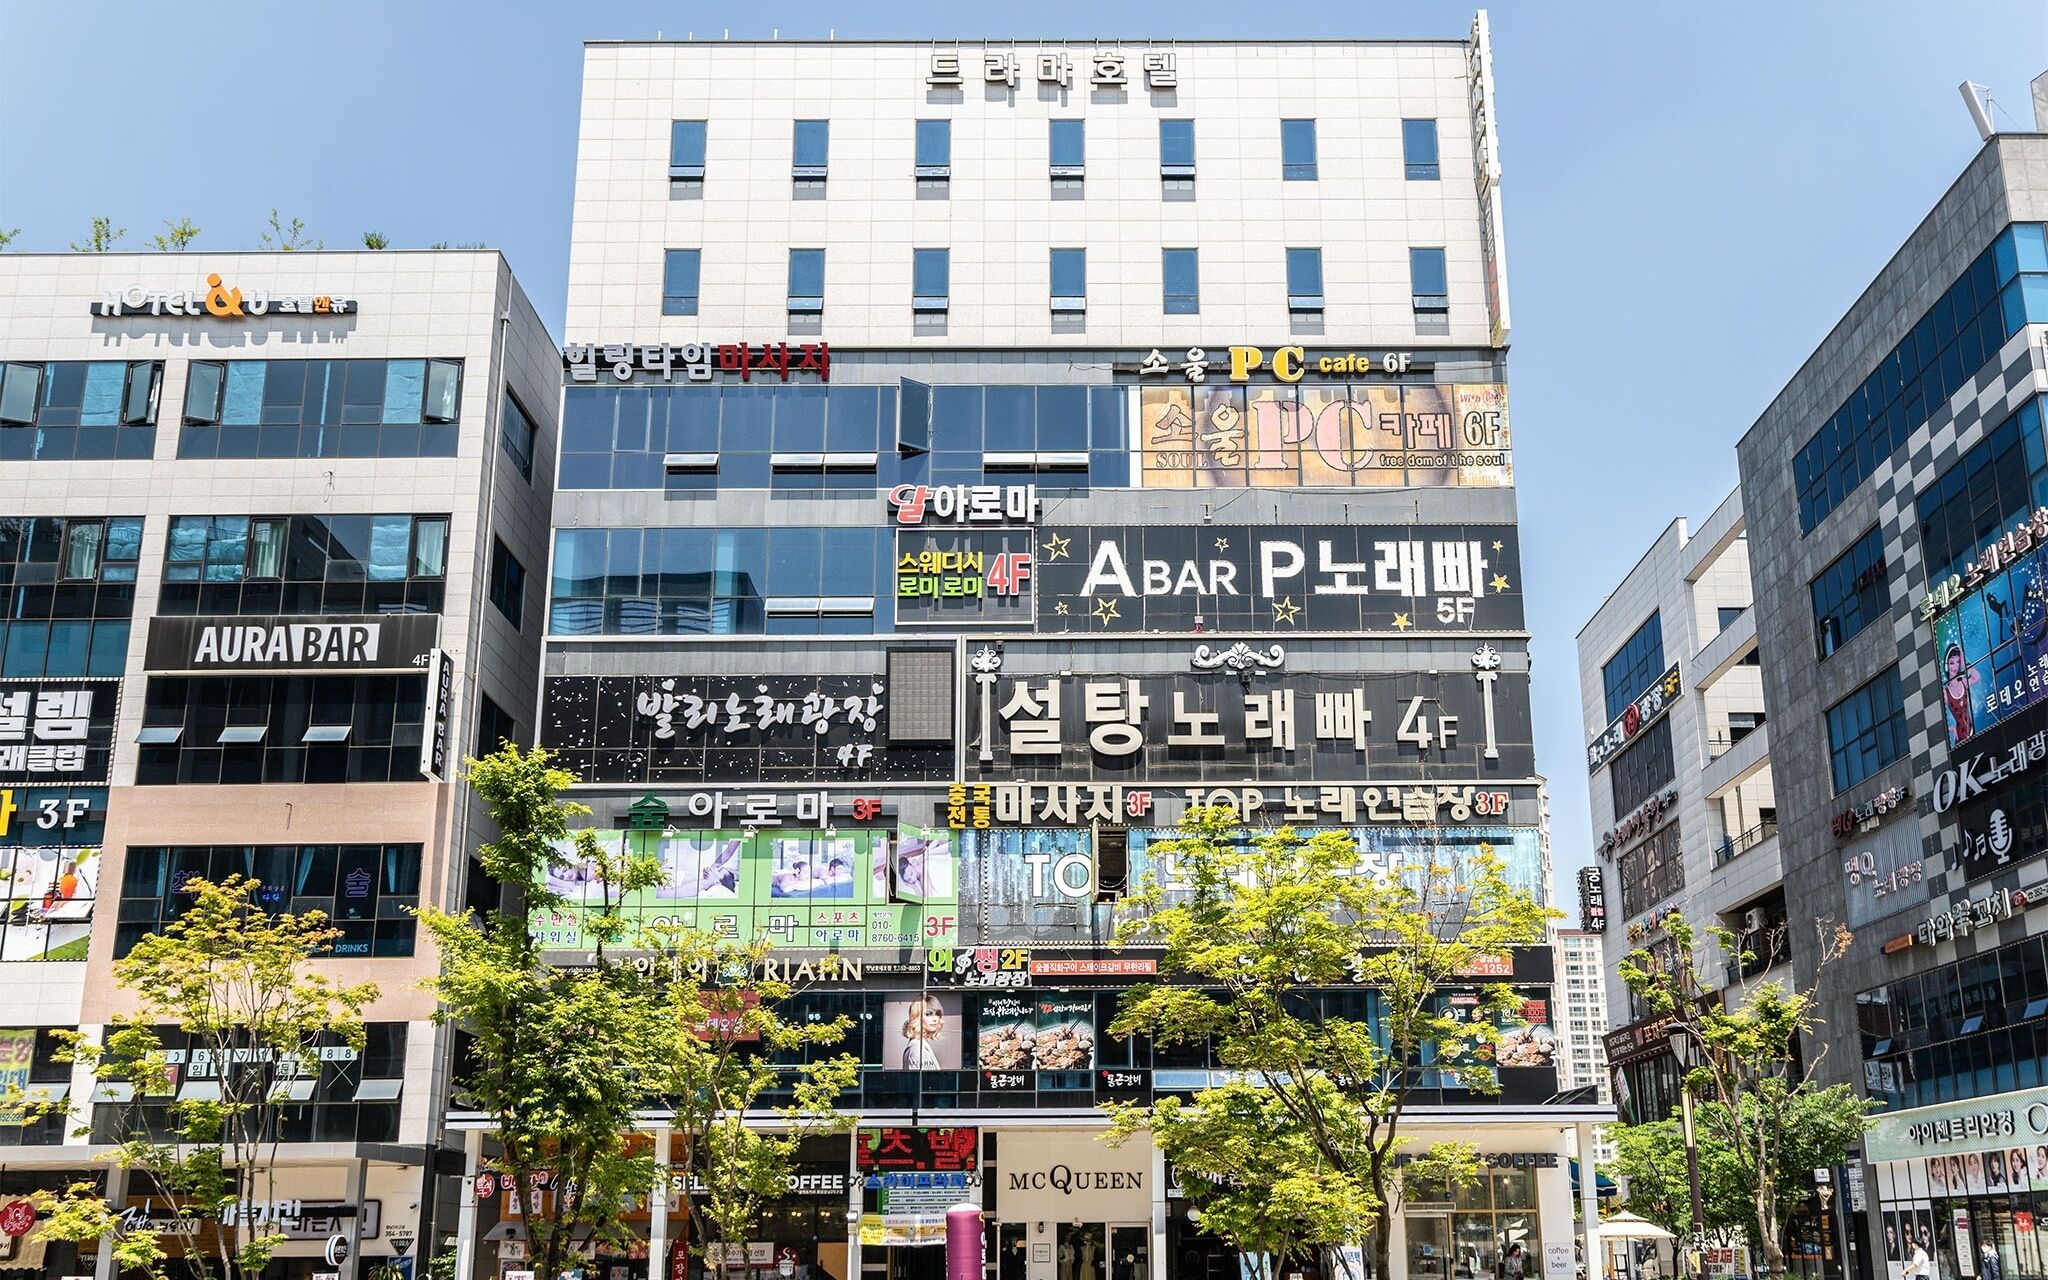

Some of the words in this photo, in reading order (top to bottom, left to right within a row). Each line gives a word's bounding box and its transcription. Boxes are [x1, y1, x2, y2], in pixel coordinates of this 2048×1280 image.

[926, 51, 1178, 88] 드라마호텔
[101, 284, 199, 316] HOTEL
[250, 290, 268, 315] U
[279, 296, 348, 313] 호텔앤유
[564, 342, 713, 382] 힐링타임
[718, 341, 830, 381] 마사지
[1228, 346, 1306, 383] PC
[1319, 352, 1370, 374] cafe
[1382, 351, 1411, 372] 6F
[1251, 399, 1375, 473] PC
[1379, 412, 1454, 450] 카페
[1463, 410, 1501, 447] 6F
[1156, 451, 1208, 469] SOUL
[1476, 454, 1505, 467] soul
[898, 550, 983, 575] 스웨디시
[986, 552, 1032, 597] 4F
[1436, 597, 1475, 623] 5F
[195, 626, 288, 663] AURA
[300, 626, 371, 663] BAR
[412, 652, 430, 667] 4F
[438, 660, 452, 717] AURA
[1985, 679, 2026, 714] 로데오
[1395, 694, 1459, 750] 4F
[434, 722, 446, 767] BAR
[835, 743, 874, 768] 4F
[37, 799, 90, 830] 3F
[687, 791, 835, 830] 아로마
[852, 798, 883, 821] 3F
[995, 784, 1123, 824] 마사지
[1126, 791, 1152, 817] 3F
[1283, 785, 1476, 823] 노래연습장
[1475, 791, 1509, 816] 3F
[816, 911, 860, 924] 스포츠
[871, 921, 893, 930] 010-
[926, 915, 955, 938] 3F
[334, 942, 369, 953] DRINKS
[815, 929, 861, 943] 아로마
[871, 933, 920, 943] 8760-6415
[1001, 949, 1029, 970] 2F
[1123, 962, 1153, 973] 무한리필
[963, 971, 1029, 987] 노래광장
[1909, 1111, 2014, 1146] 아이젠트리안경
[1483, 1152, 1559, 1169] COFFEE
[1547, 1246, 1570, 1255] coffee
[1551, 1260, 1568, 1270] beer
